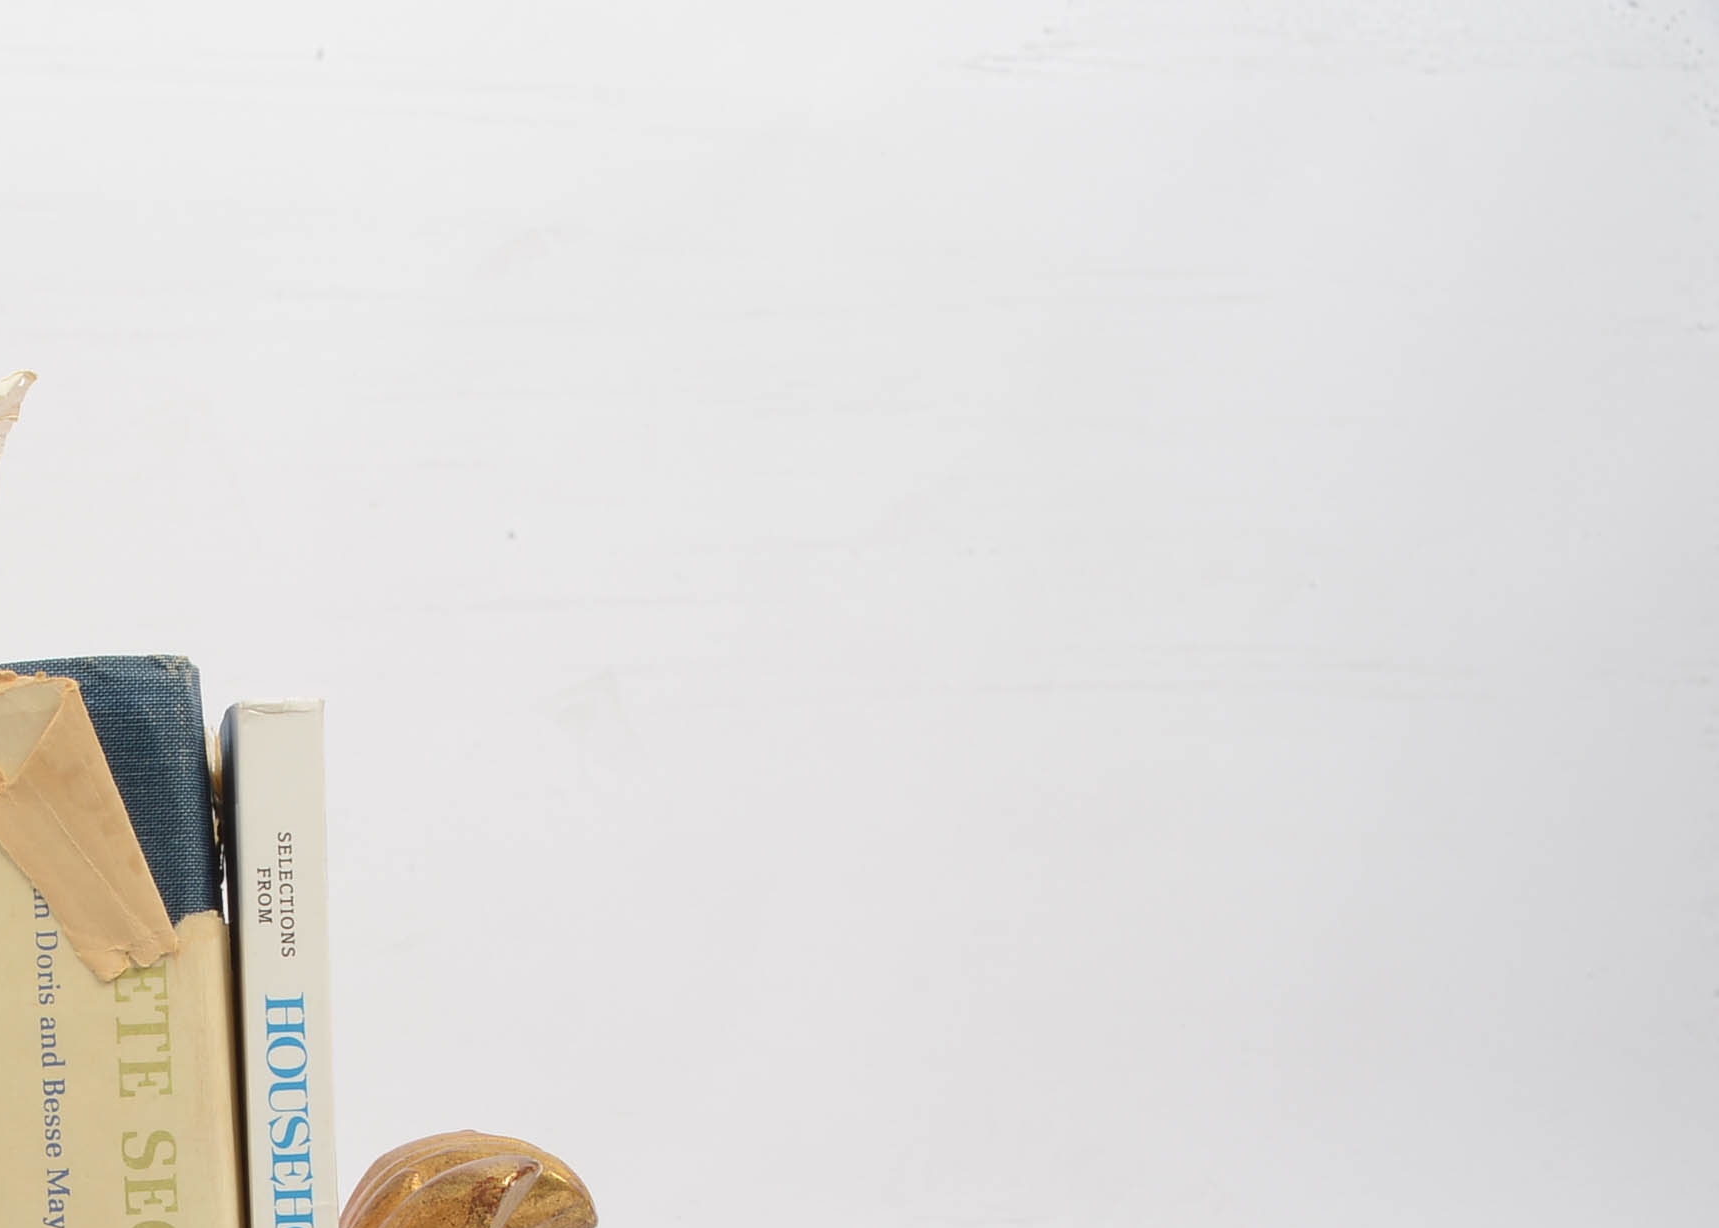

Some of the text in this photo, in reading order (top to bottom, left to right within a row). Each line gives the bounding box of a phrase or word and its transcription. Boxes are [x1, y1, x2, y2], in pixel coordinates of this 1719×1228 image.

[257, 867, 273, 924] FROM
[277, 832, 296, 958] SELECTIONS
[35, 931, 59, 1006] Doris
[39, 1016, 66, 1068] and
[42, 1078, 66, 1158] Besse
